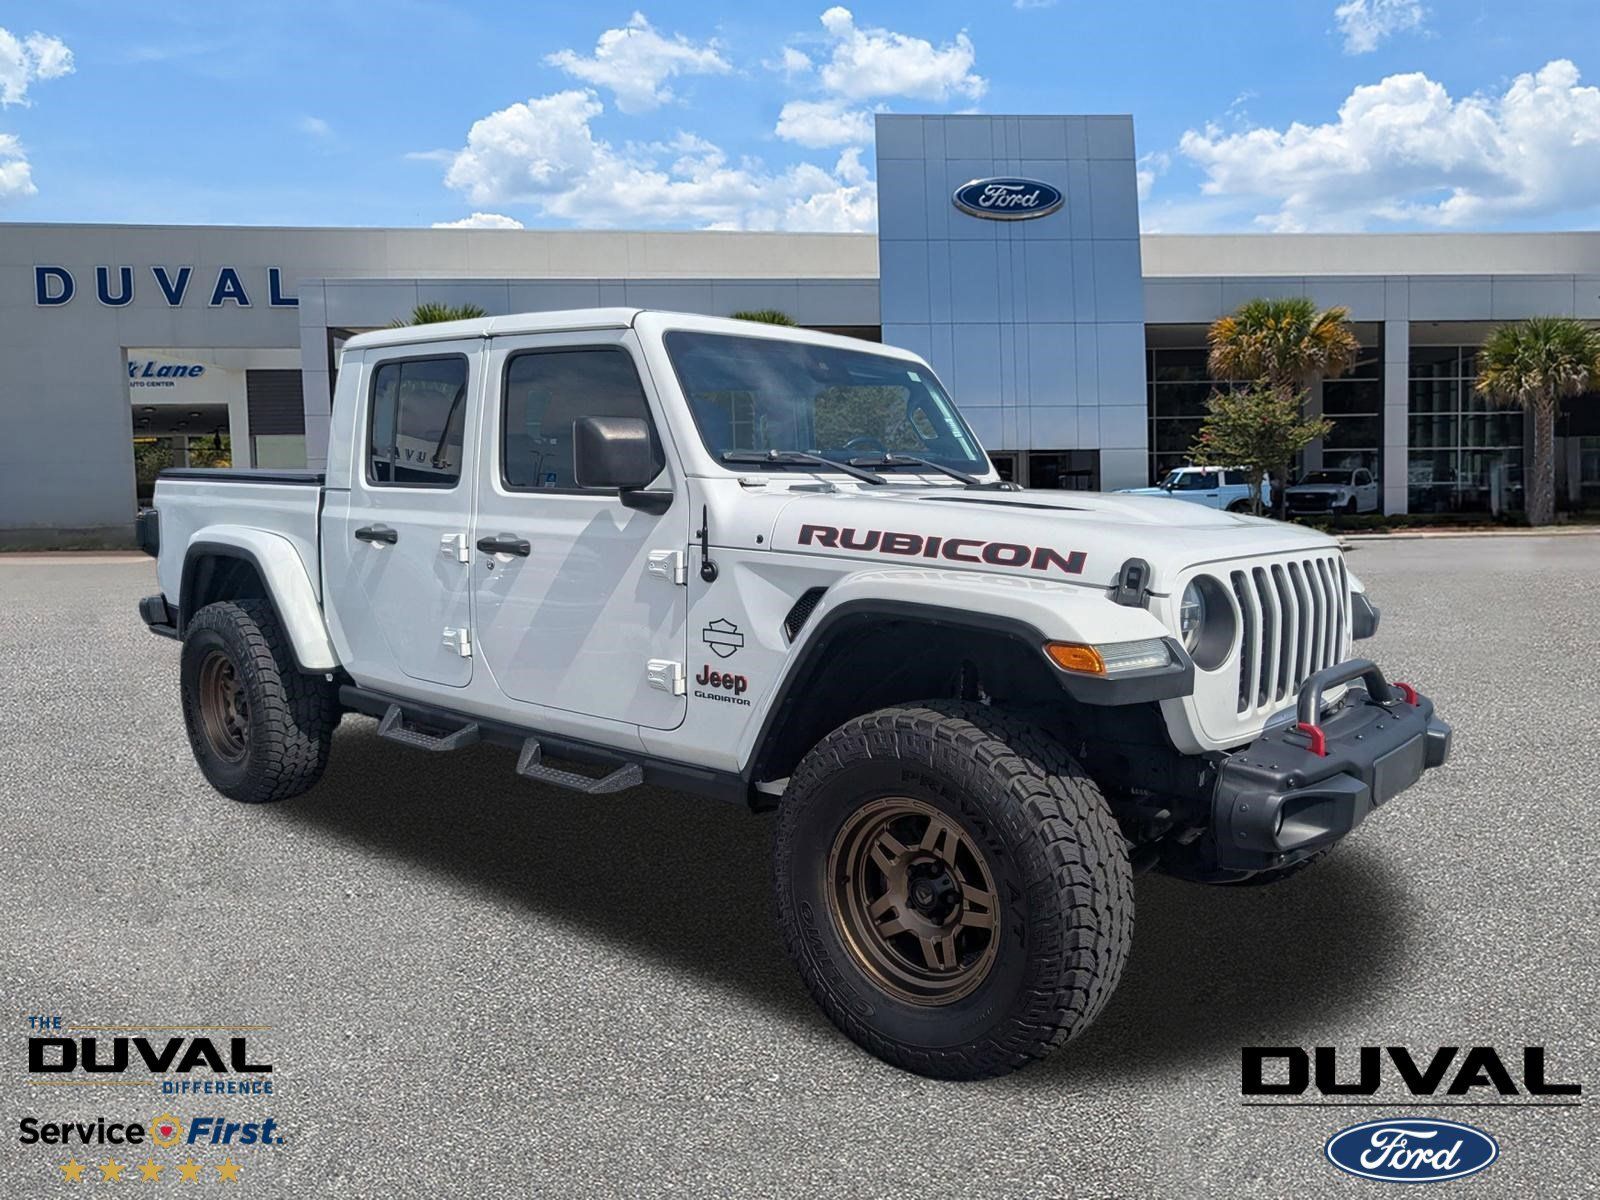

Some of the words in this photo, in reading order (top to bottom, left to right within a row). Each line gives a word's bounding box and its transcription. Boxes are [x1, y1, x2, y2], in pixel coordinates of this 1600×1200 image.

[978, 184, 1040, 207] Ford
[34, 265, 300, 307] DUVAL
[142, 361, 204, 378] Lane
[797, 524, 1088, 575] RUBICON
[696, 664, 748, 695] Jeep
[694, 690, 751, 707] GLADIATOR
